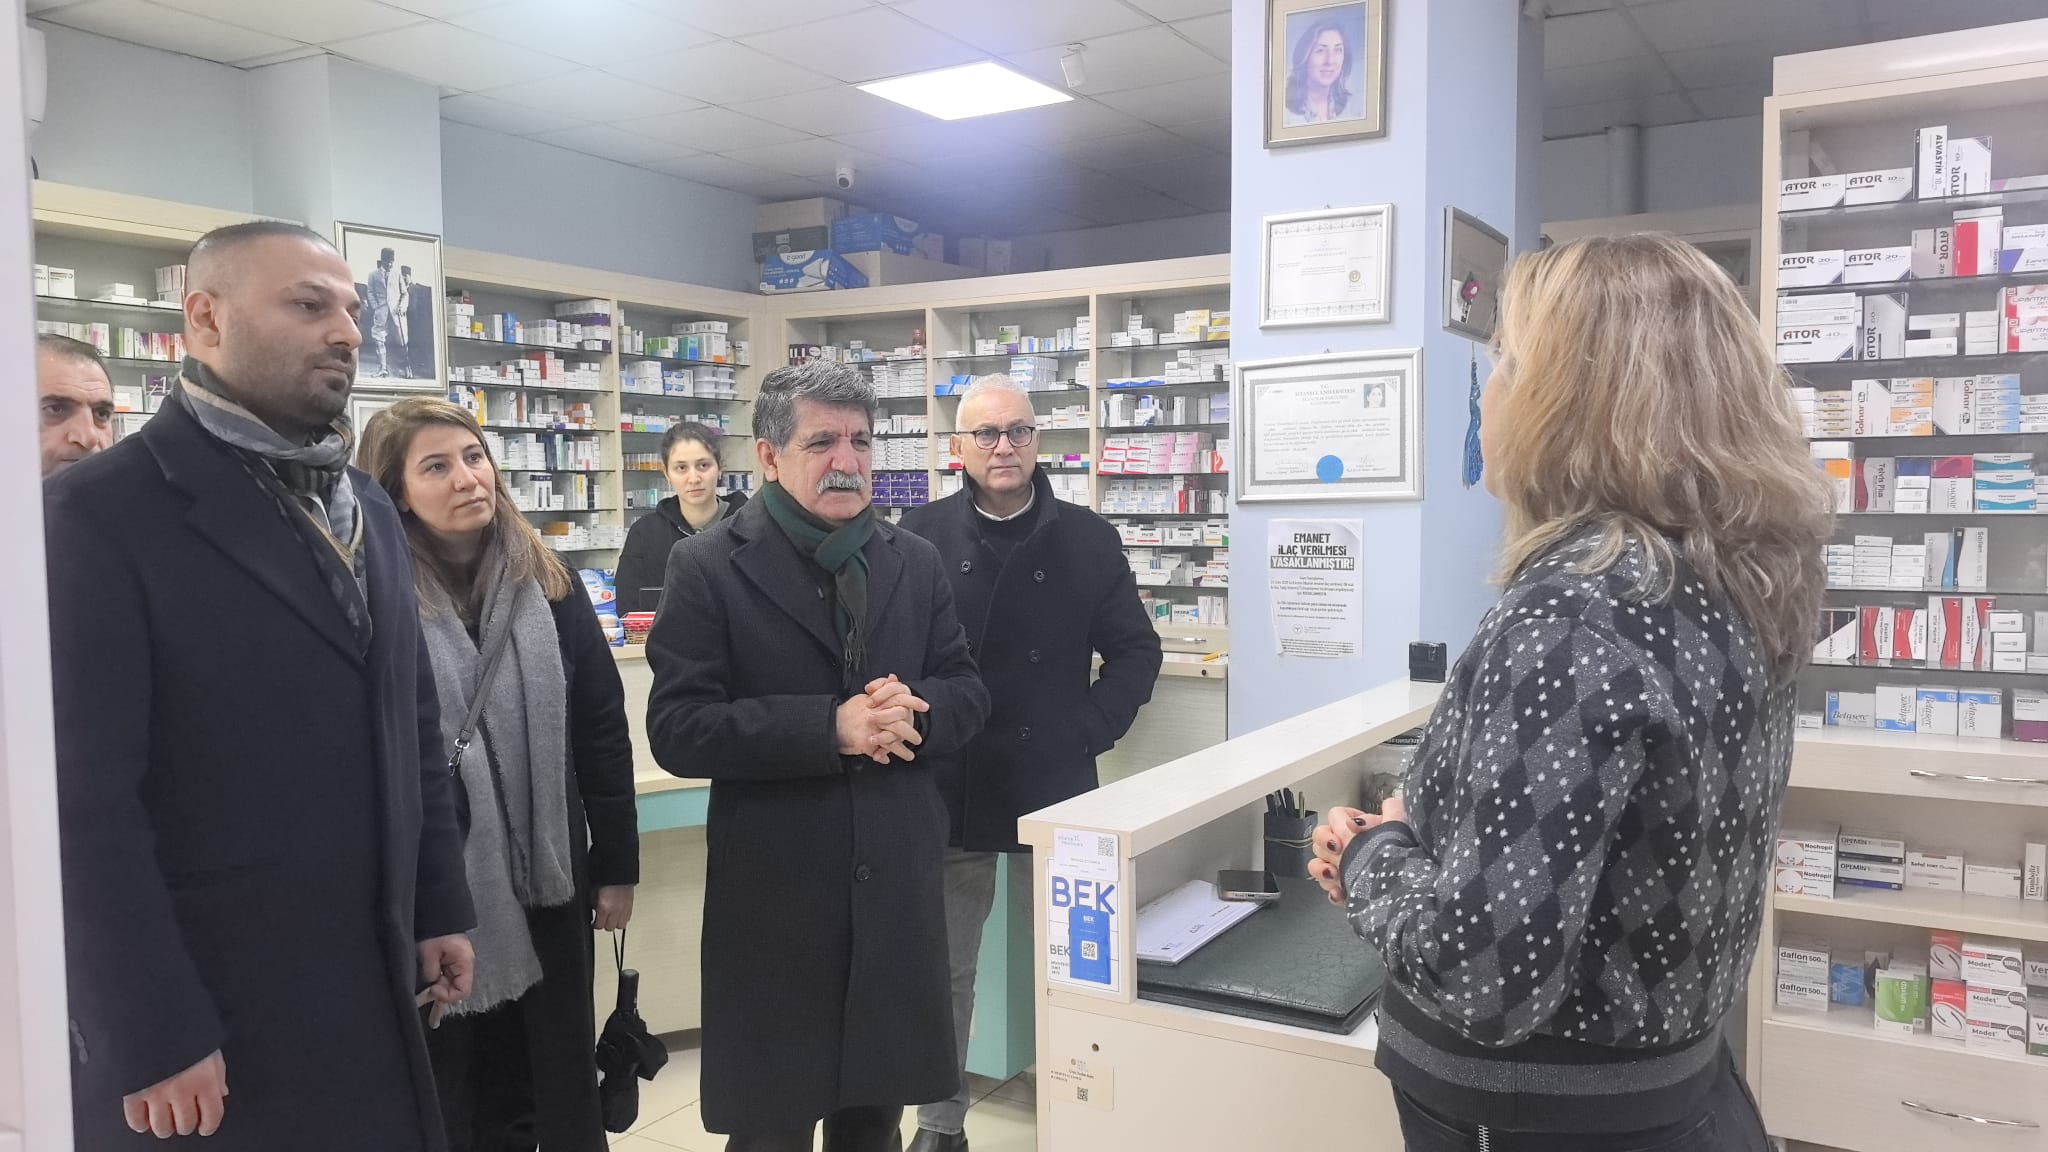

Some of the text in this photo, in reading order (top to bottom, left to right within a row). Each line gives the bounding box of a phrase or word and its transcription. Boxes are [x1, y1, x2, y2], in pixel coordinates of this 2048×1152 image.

[1849, 175, 1882, 186] ATOR
[1785, 181, 1817, 192] ATOR
[1939, 230, 1949, 260] ATOR
[1782, 256, 1815, 266] ATOR
[1848, 253, 1881, 263] ATOR
[1783, 329, 1821, 340] ATOR
[1867, 326, 1877, 358] ATOR
[1294, 533, 1331, 544] EMANET
[1271, 557, 1354, 571] YASAKLANMIŞTIR!
[1052, 876, 1116, 915] BEK
[1050, 944, 1070, 956] BEK
[1780, 950, 1808, 961] daflon
[1967, 959, 1991, 968] Modet
[1779, 983, 1807, 993] daflon
[1973, 994, 1997, 1003] Modet
[1972, 1028, 1996, 1037] Modet
